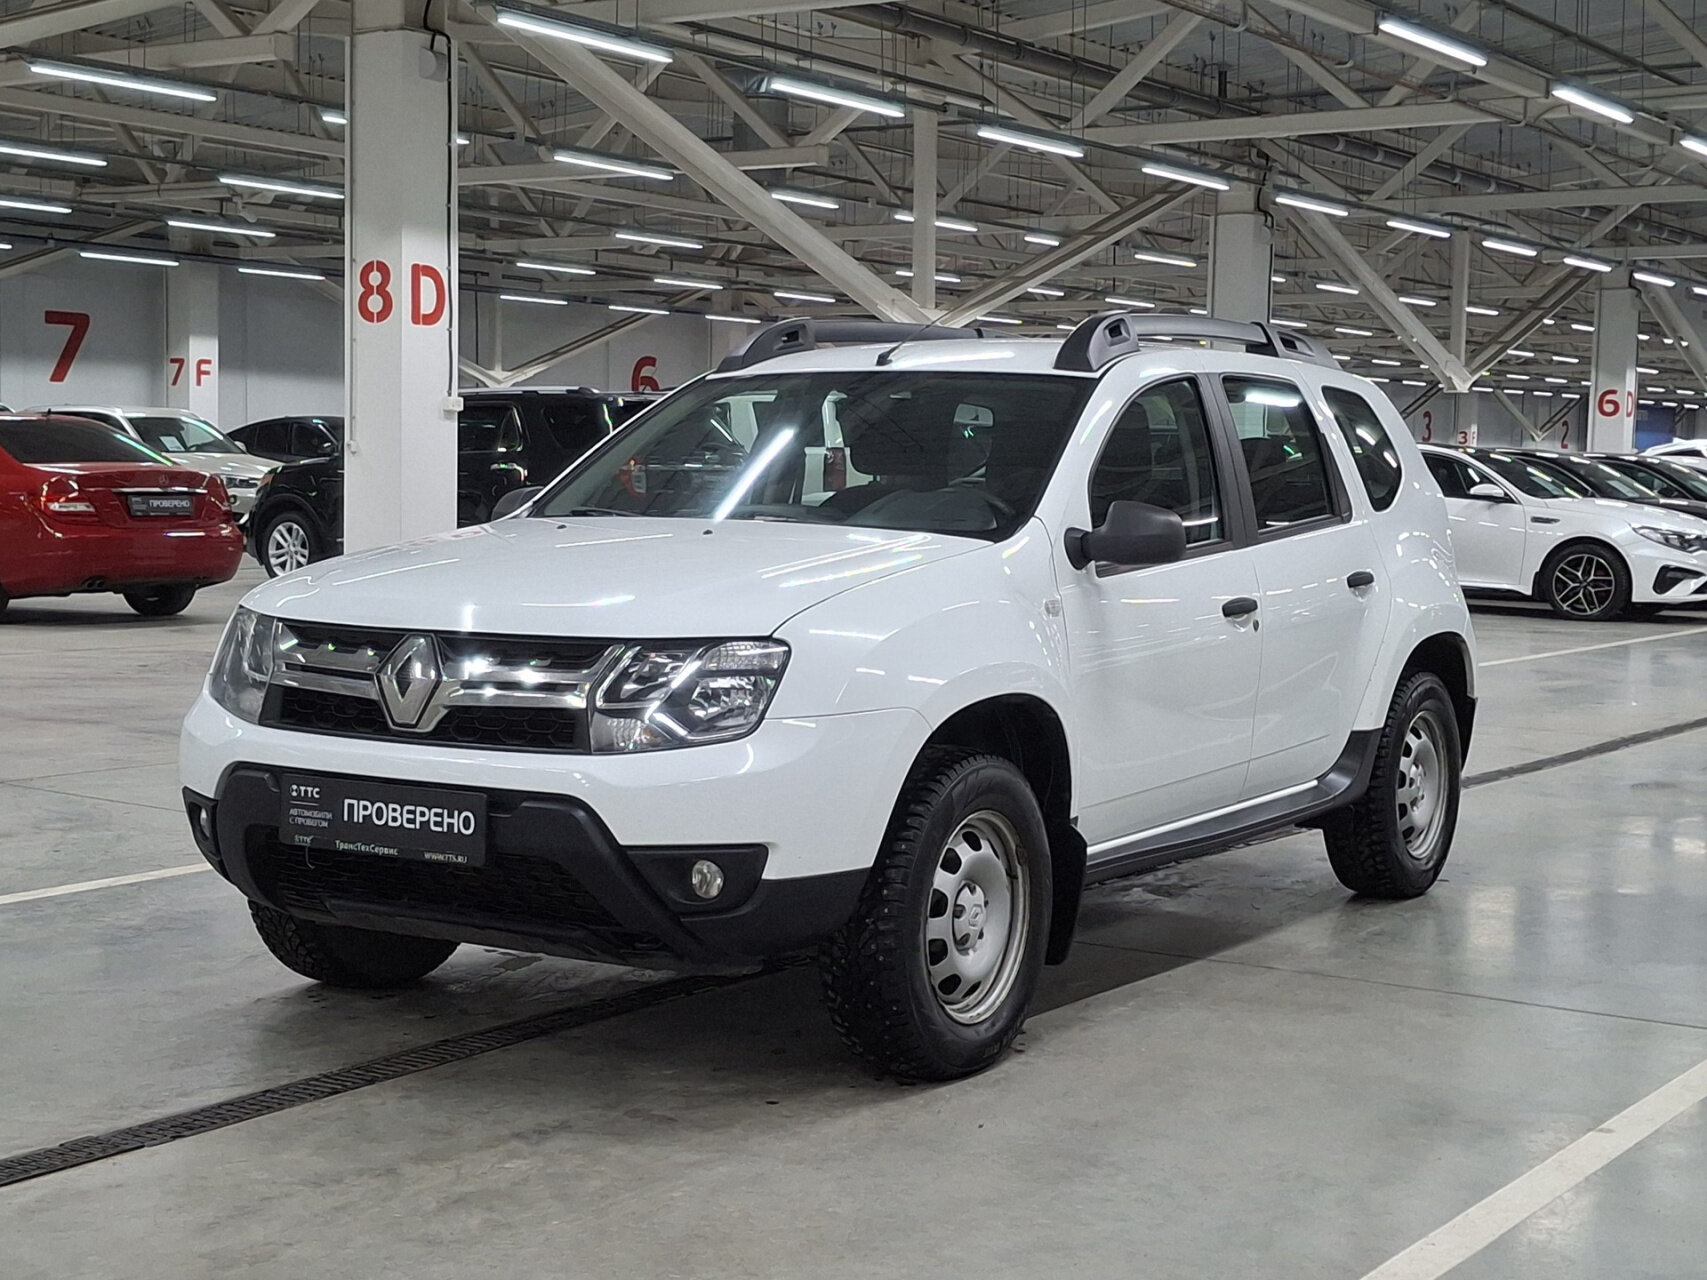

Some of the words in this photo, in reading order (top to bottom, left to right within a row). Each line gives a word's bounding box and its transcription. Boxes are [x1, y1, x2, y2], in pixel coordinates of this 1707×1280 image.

[358, 260, 394, 324] 8
[411, 263, 446, 327] D
[44, 310, 90, 383] 7
[169, 357, 186, 387] 7
[196, 358, 212, 387] F
[1597, 389, 1621, 417] 6
[1626, 390, 1634, 418] D
[1421, 410, 1433, 443] 3
[1458, 430, 1468, 445] 3
[1560, 420, 1570, 449] 2
[149, 499, 190, 508] ПРОВЕРЕНО
[343, 798, 475, 836] ПРОВЕРЕНО
[335, 840, 399, 856] ТрансТехСервис
